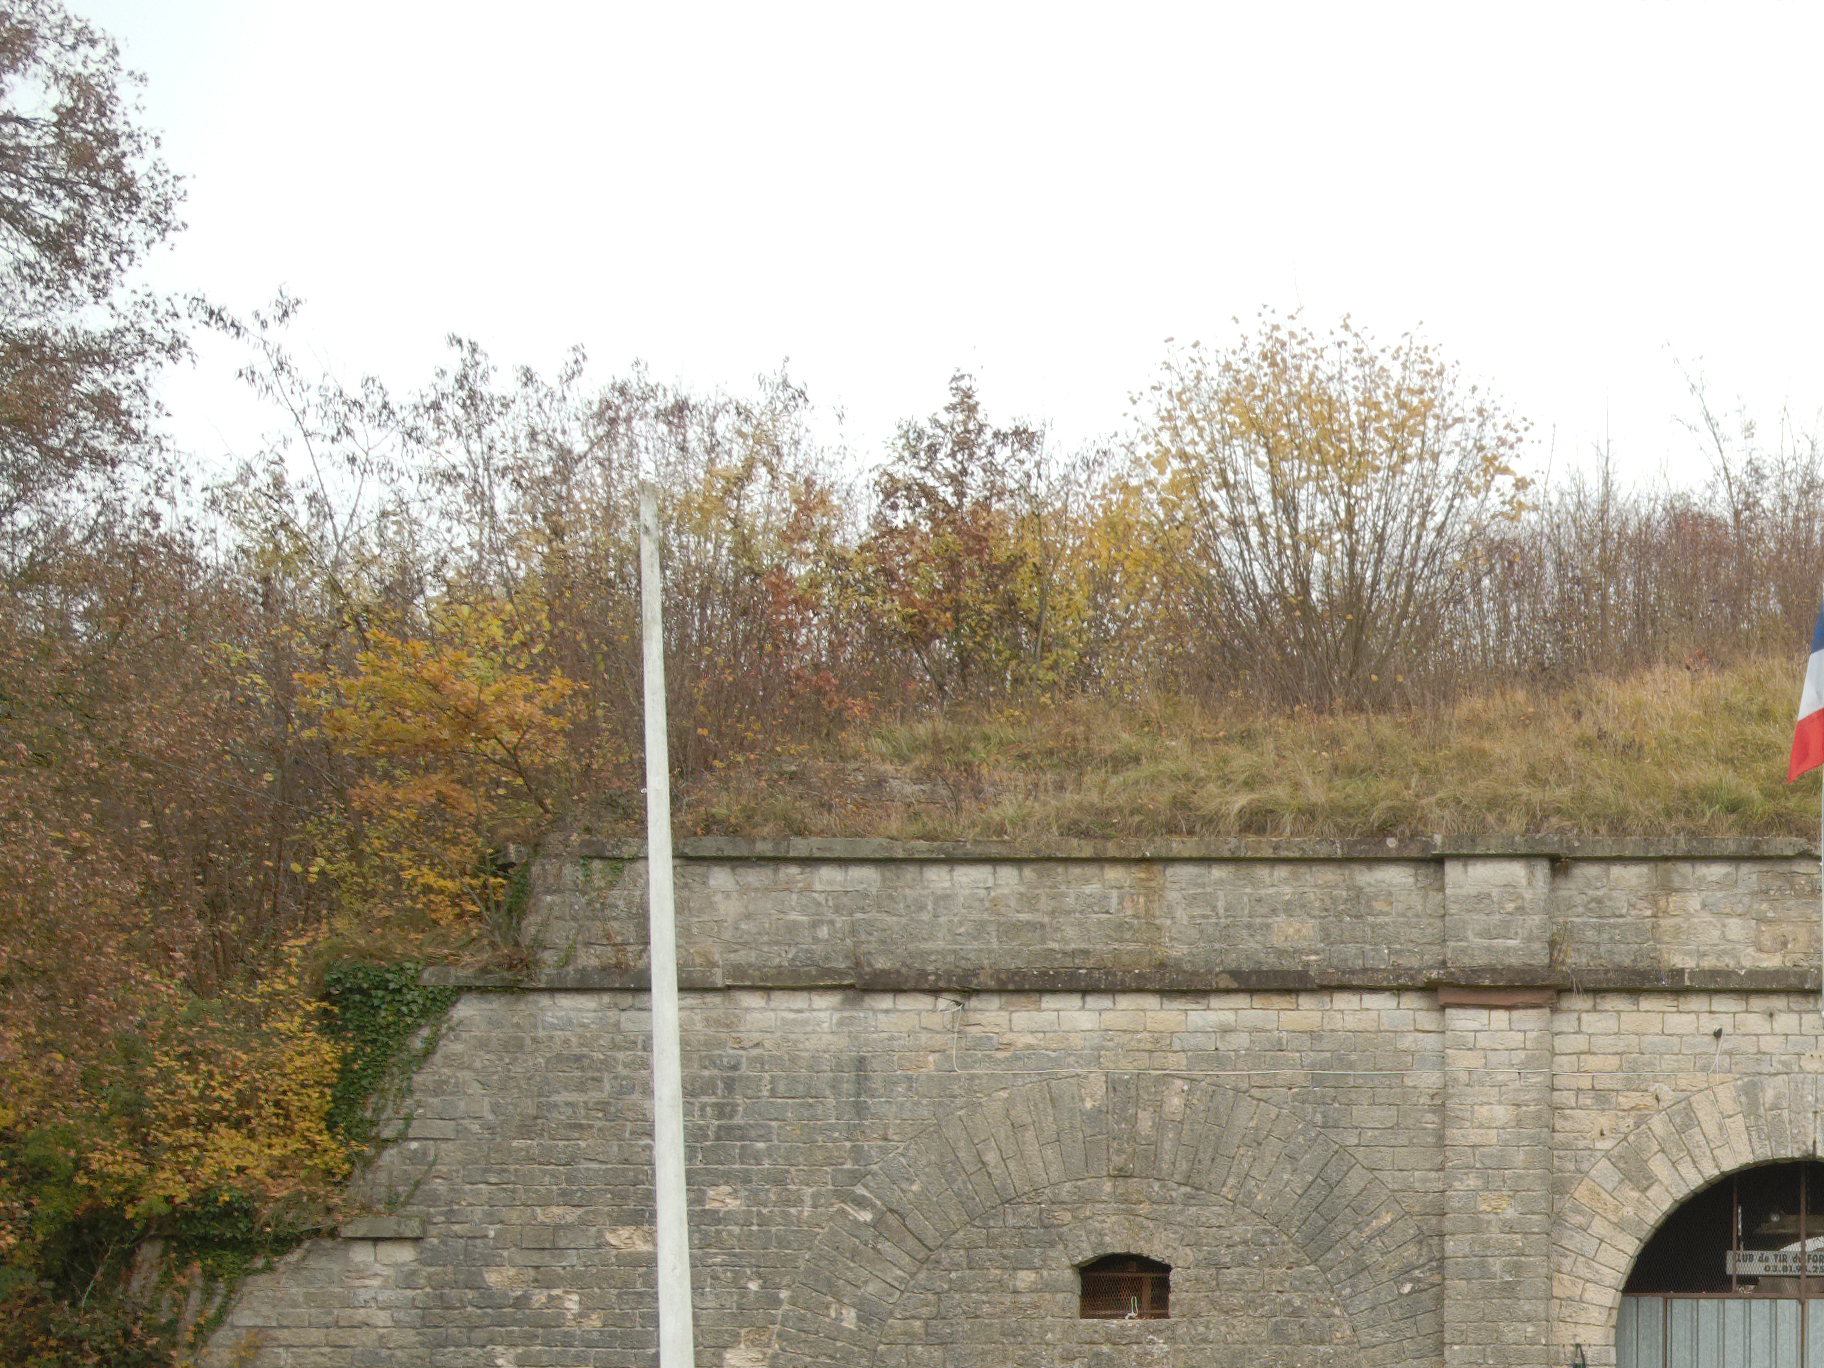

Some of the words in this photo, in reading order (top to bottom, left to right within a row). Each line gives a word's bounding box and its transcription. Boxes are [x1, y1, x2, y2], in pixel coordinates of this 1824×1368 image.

[1735, 1253, 1754, 1263] LUB
[1758, 1253, 1769, 1262] de
[1773, 1253, 1788, 1263] TIR
